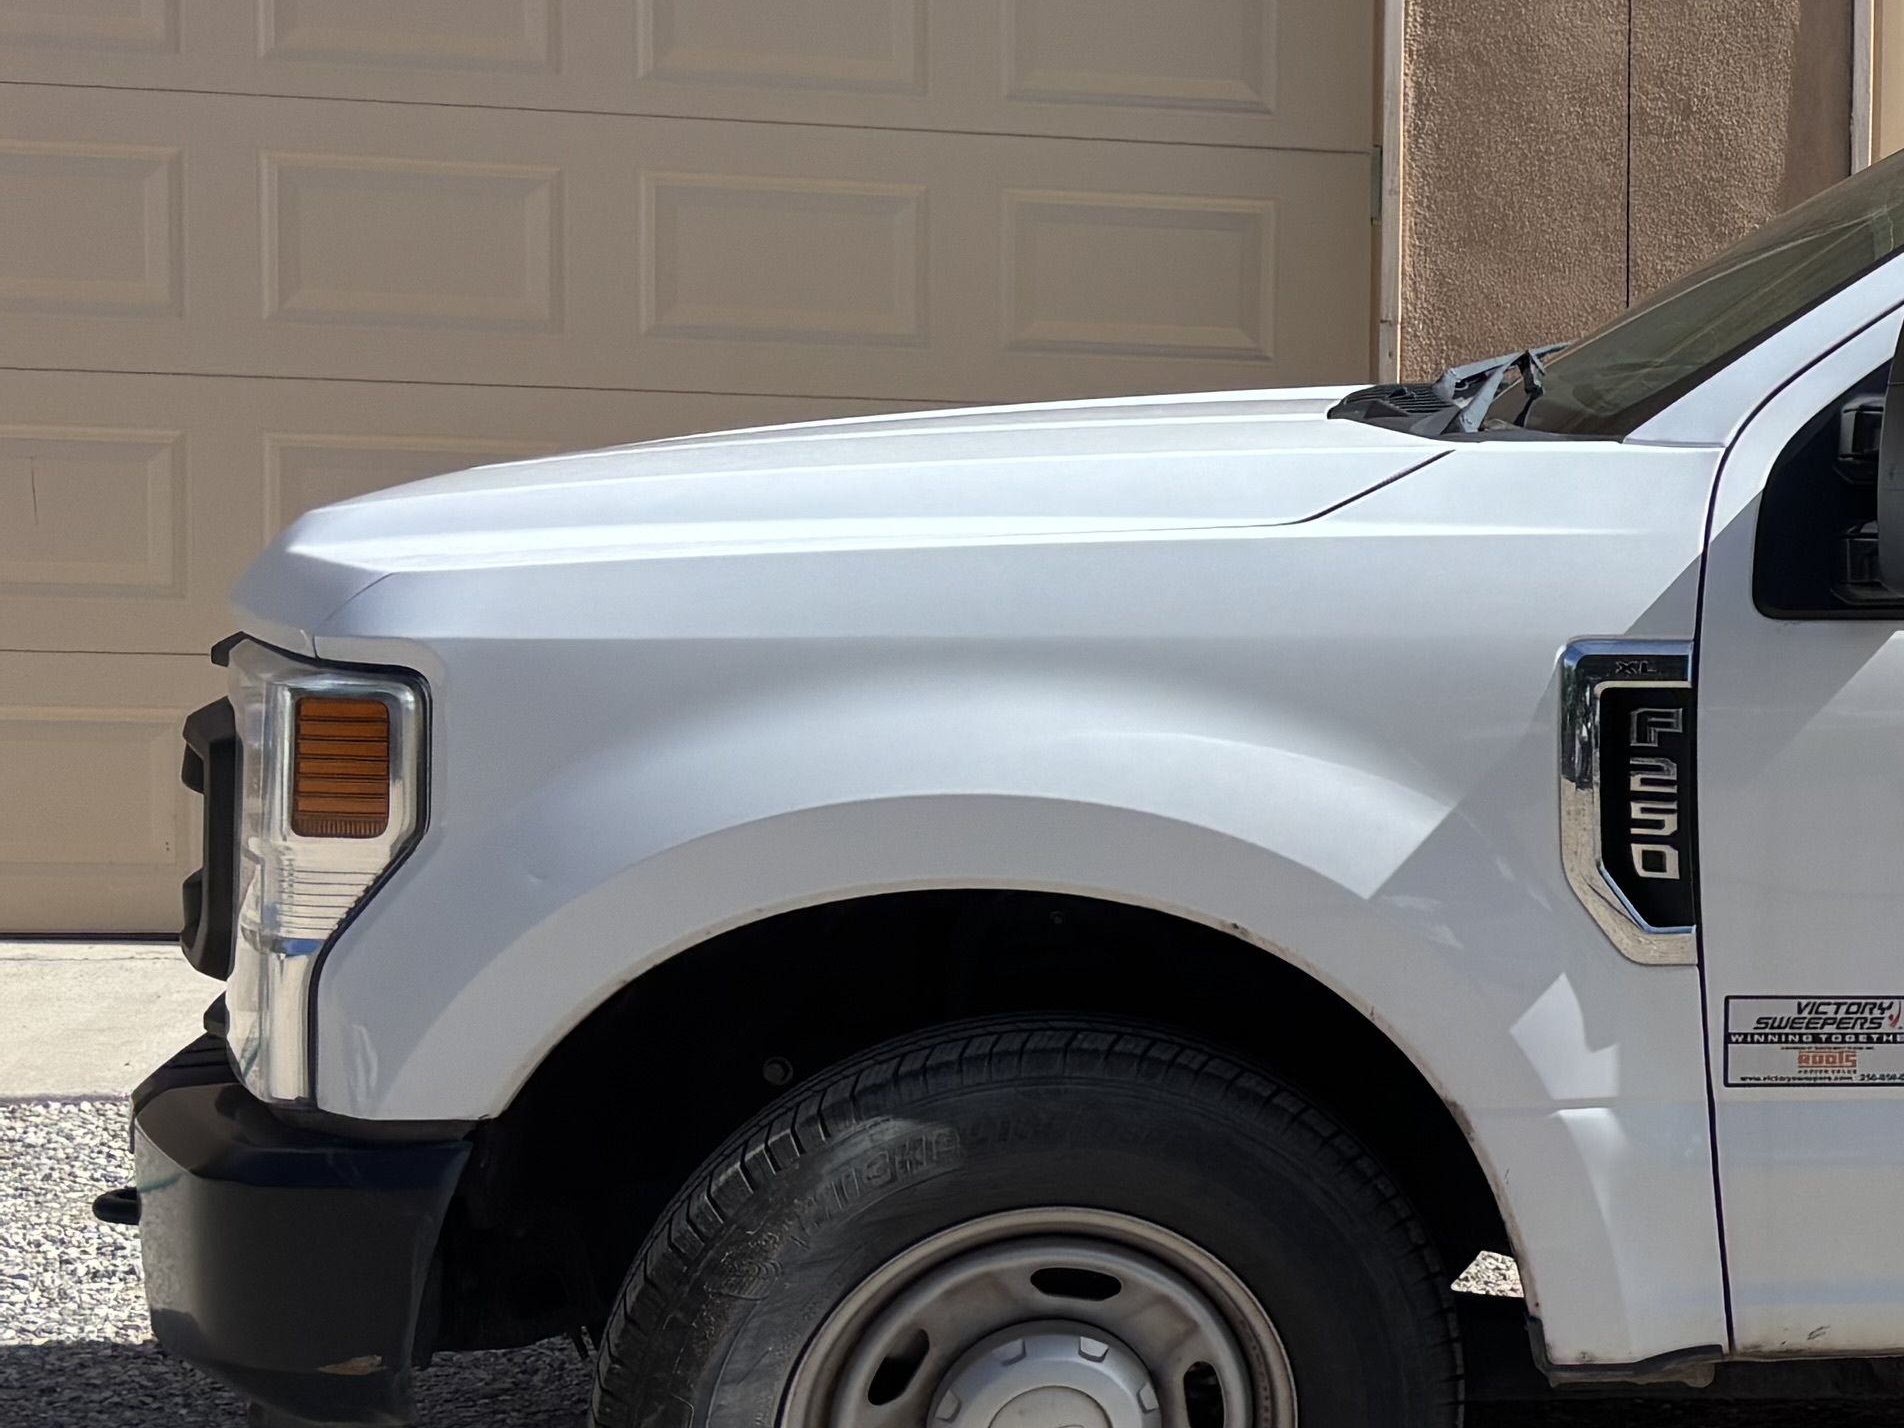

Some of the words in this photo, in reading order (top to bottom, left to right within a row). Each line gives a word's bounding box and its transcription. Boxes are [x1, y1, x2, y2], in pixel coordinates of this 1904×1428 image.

[1615, 660, 1657, 675] XL
[1796, 1001, 1895, 1016] VICTORY
[1752, 1016, 1885, 1030] SWEEPERS
[1730, 1034, 1814, 1042] WINNING
